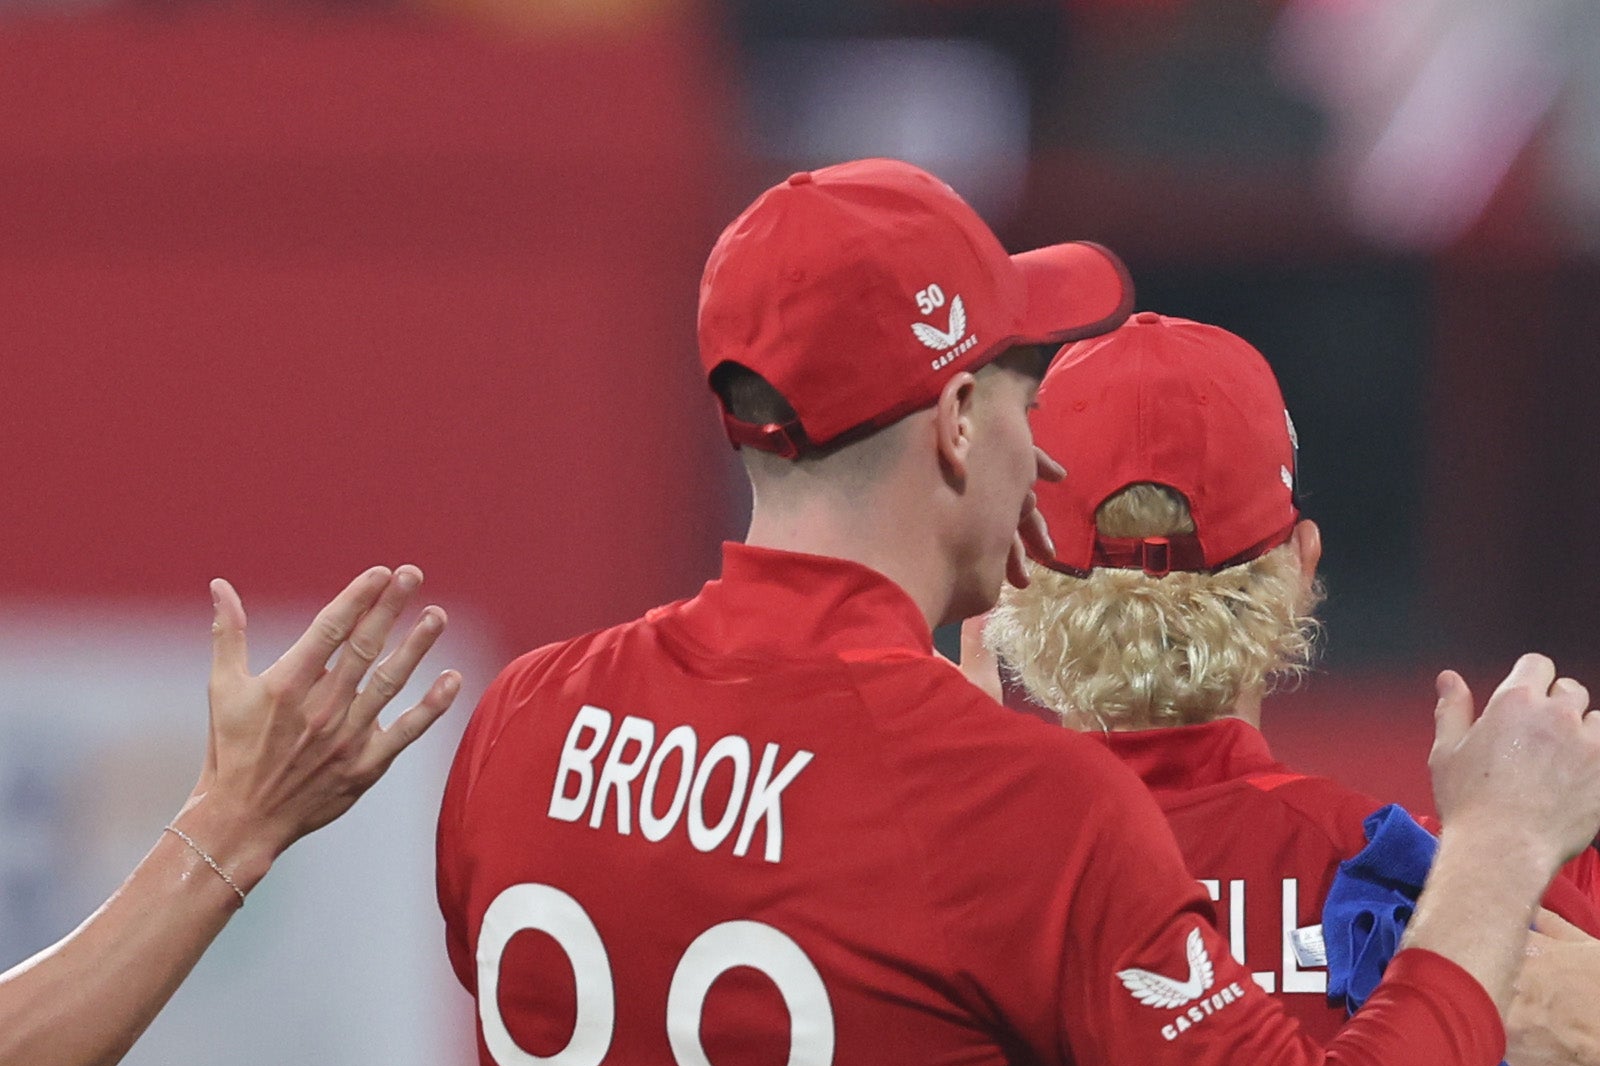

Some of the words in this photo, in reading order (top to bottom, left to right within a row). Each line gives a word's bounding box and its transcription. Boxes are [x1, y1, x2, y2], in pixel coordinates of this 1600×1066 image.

[915, 284, 945, 314] 50
[932, 333, 978, 370] CASTORE
[548, 705, 815, 863] BROOK
[1197, 878, 1328, 993] LL
[1160, 982, 1246, 1042] CASTORE
